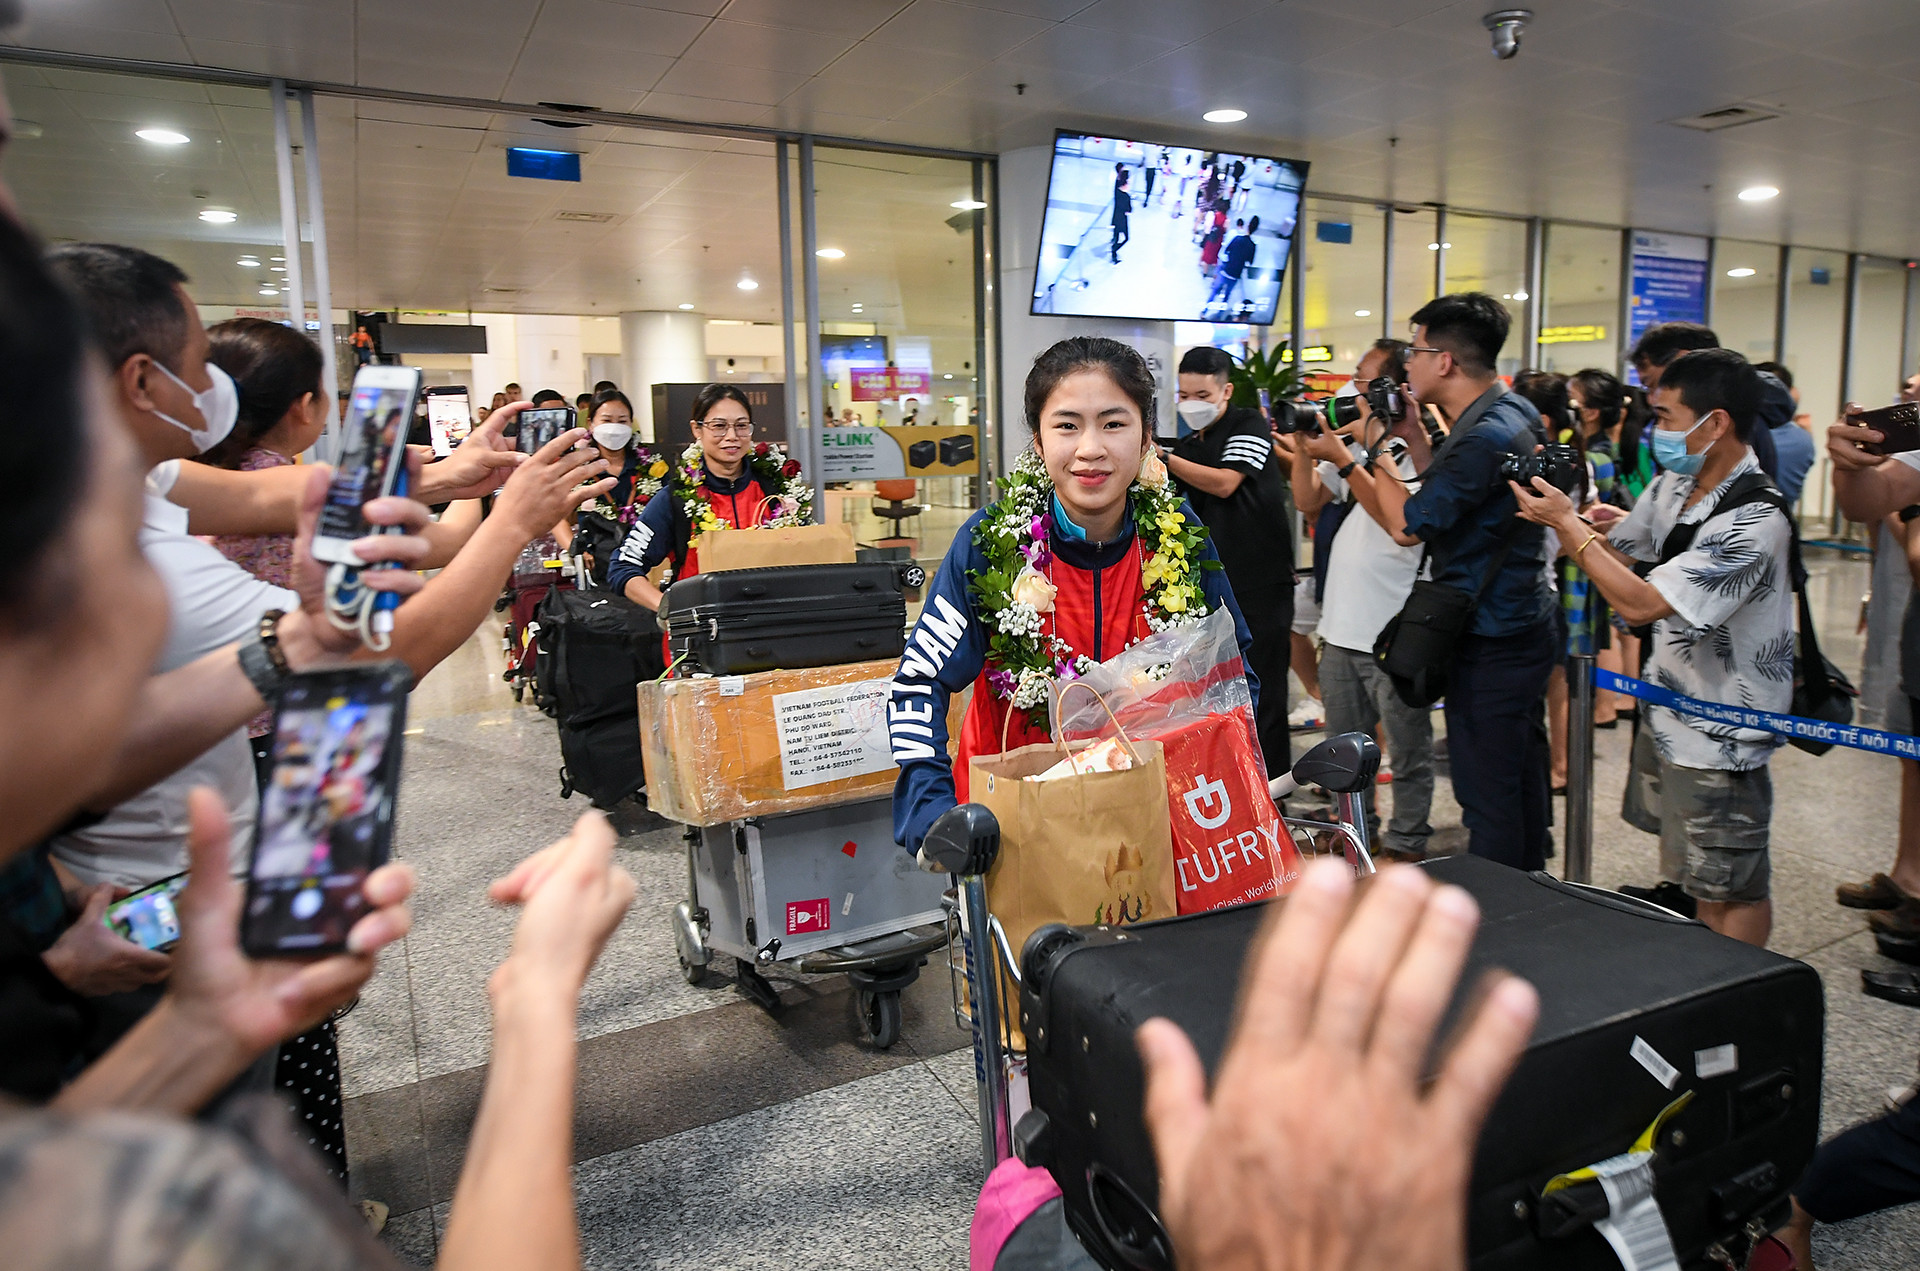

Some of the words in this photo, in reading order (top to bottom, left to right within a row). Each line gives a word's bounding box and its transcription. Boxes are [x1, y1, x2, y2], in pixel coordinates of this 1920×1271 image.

[888, 593, 968, 762] VIETNAM
[781, 702, 812, 714] VIETNAM
[813, 698, 845, 709] FOOTBALL
[846, 691, 885, 703] FEDERATION
[783, 716, 791, 724] LE
[793, 713, 816, 723] QUANG
[818, 710, 832, 718] DAO
[785, 726, 799, 734] PHU
[801, 724, 811, 732] DO
[1795, 722, 1837, 741] QUỐC
[1839, 728, 1860, 745] TẾ
[787, 737, 802, 745] NAM
[814, 732, 829, 740] LIEM
[813, 740, 842, 751] VIETNAM
[1206, 895, 1246, 911] Class.
[789, 906, 797, 932] FRAGILE
